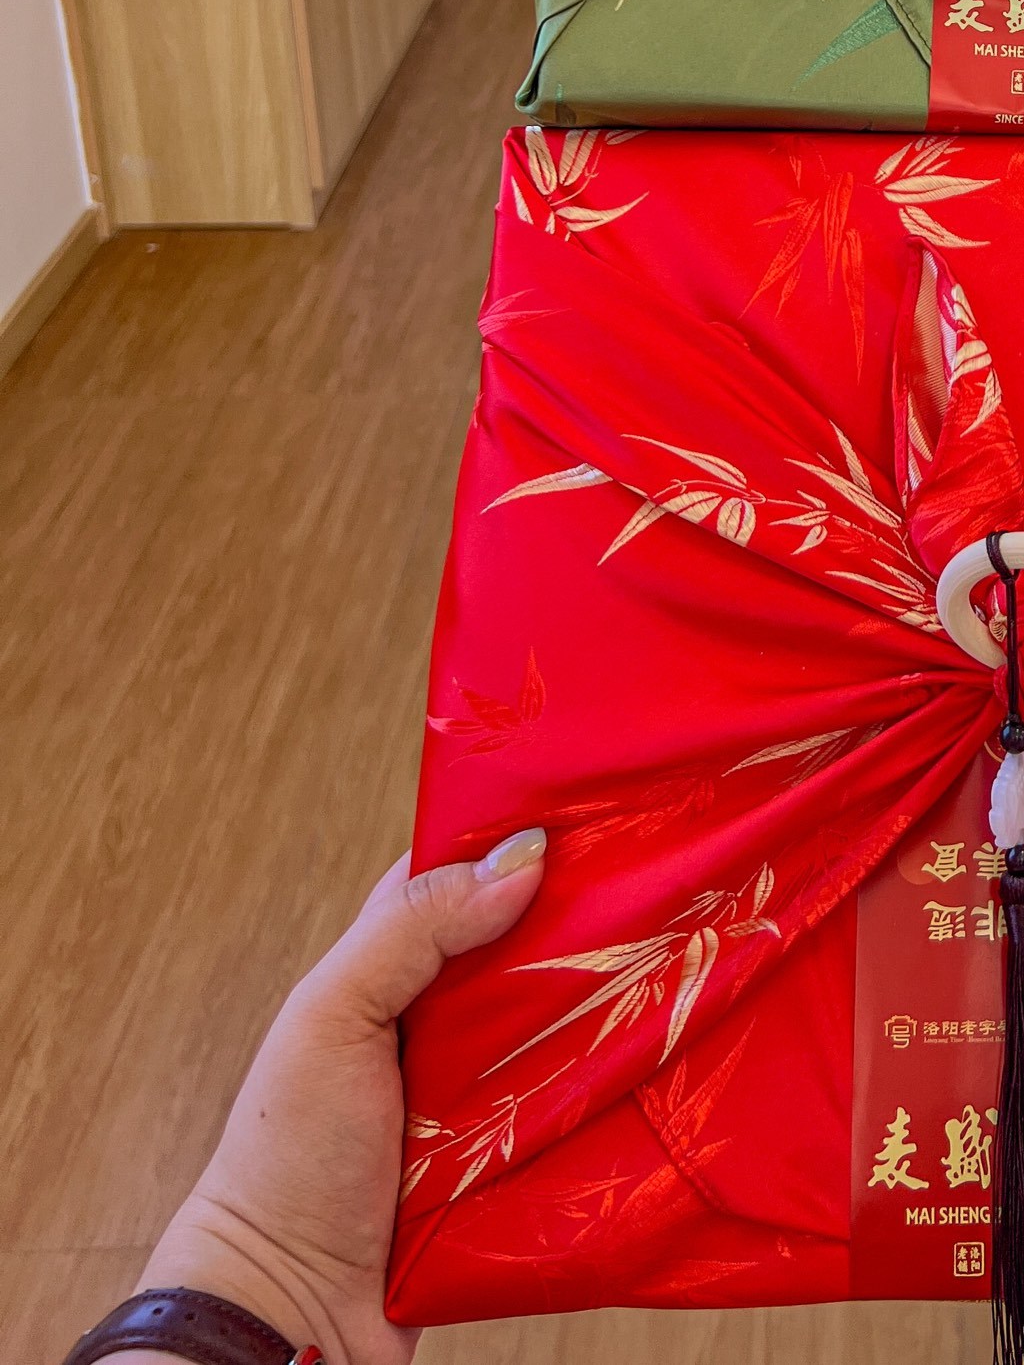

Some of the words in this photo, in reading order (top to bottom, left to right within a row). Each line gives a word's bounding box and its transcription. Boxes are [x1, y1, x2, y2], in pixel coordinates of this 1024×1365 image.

[974, 43, 998, 56] MAI
[994, 114, 1024, 125] SINCE
[905, 1206, 936, 1225] MAI
[939, 1206, 991, 1225] SHENG
